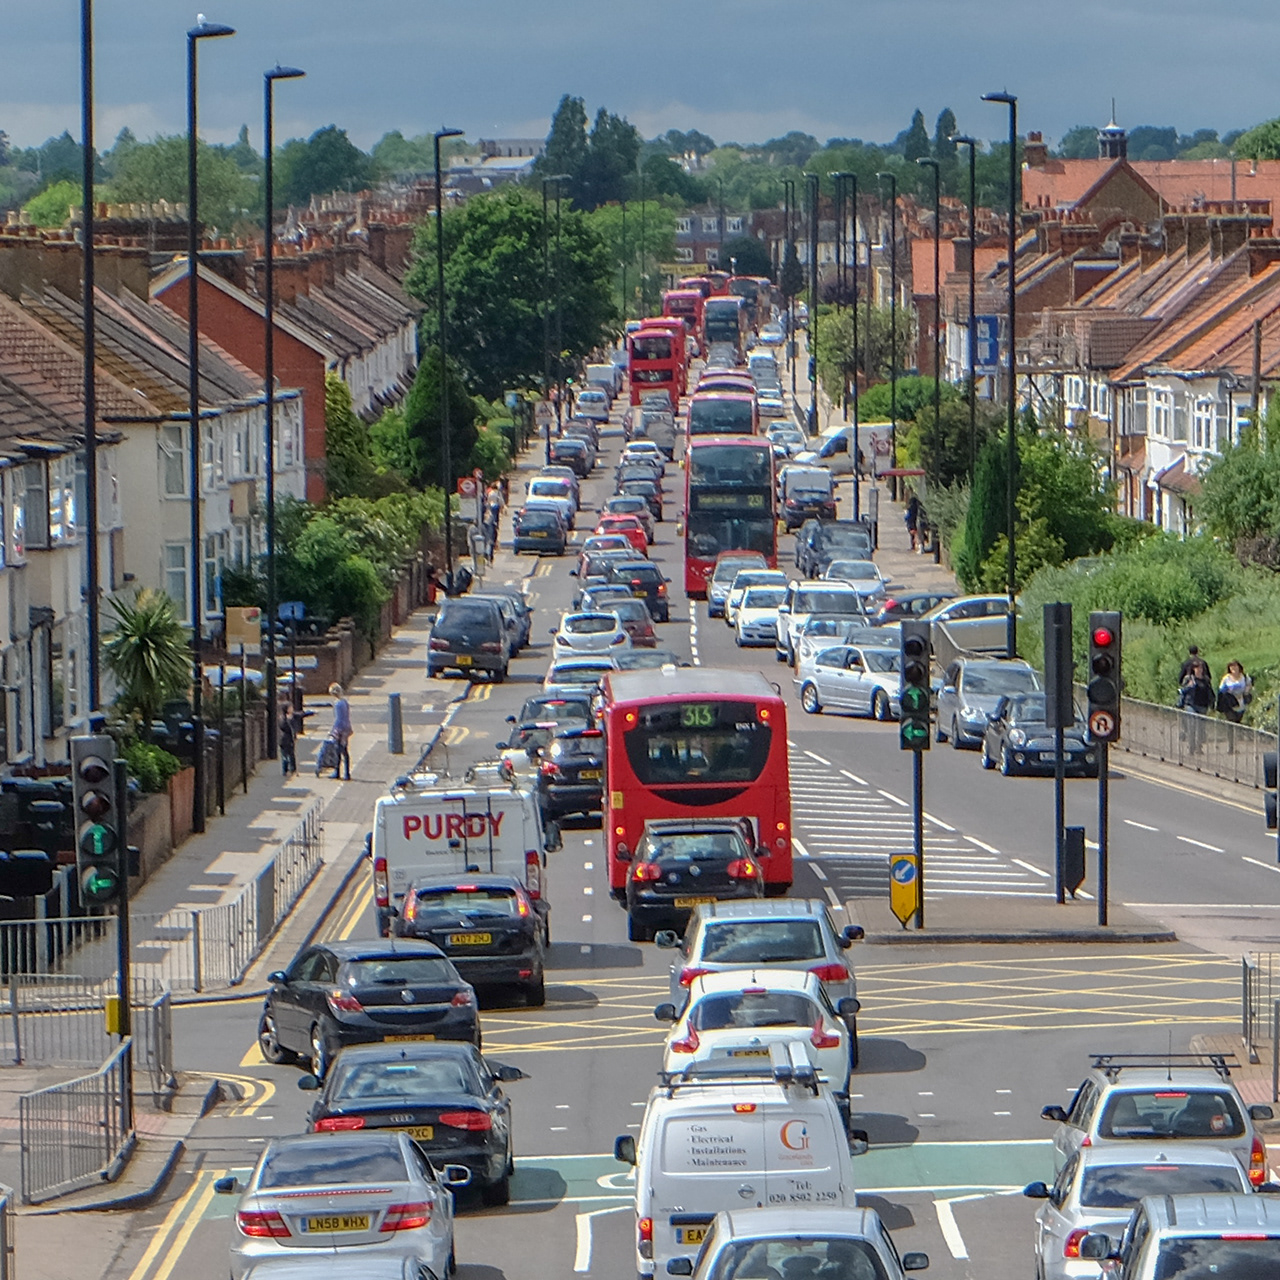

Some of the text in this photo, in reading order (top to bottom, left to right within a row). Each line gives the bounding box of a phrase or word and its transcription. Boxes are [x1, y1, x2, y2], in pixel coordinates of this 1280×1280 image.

[683, 704, 713, 727] 313
[402, 810, 505, 841] PURDY
[690, 1124, 707, 1133] Gas
[690, 1135, 734, 1144] Electrical
[690, 1146, 747, 1155] Installations
[691, 1158, 748, 1167] Maintenance
[768, 1193, 786, 1203] 020
[308, 1215, 366, 1230] LN58 WHX
